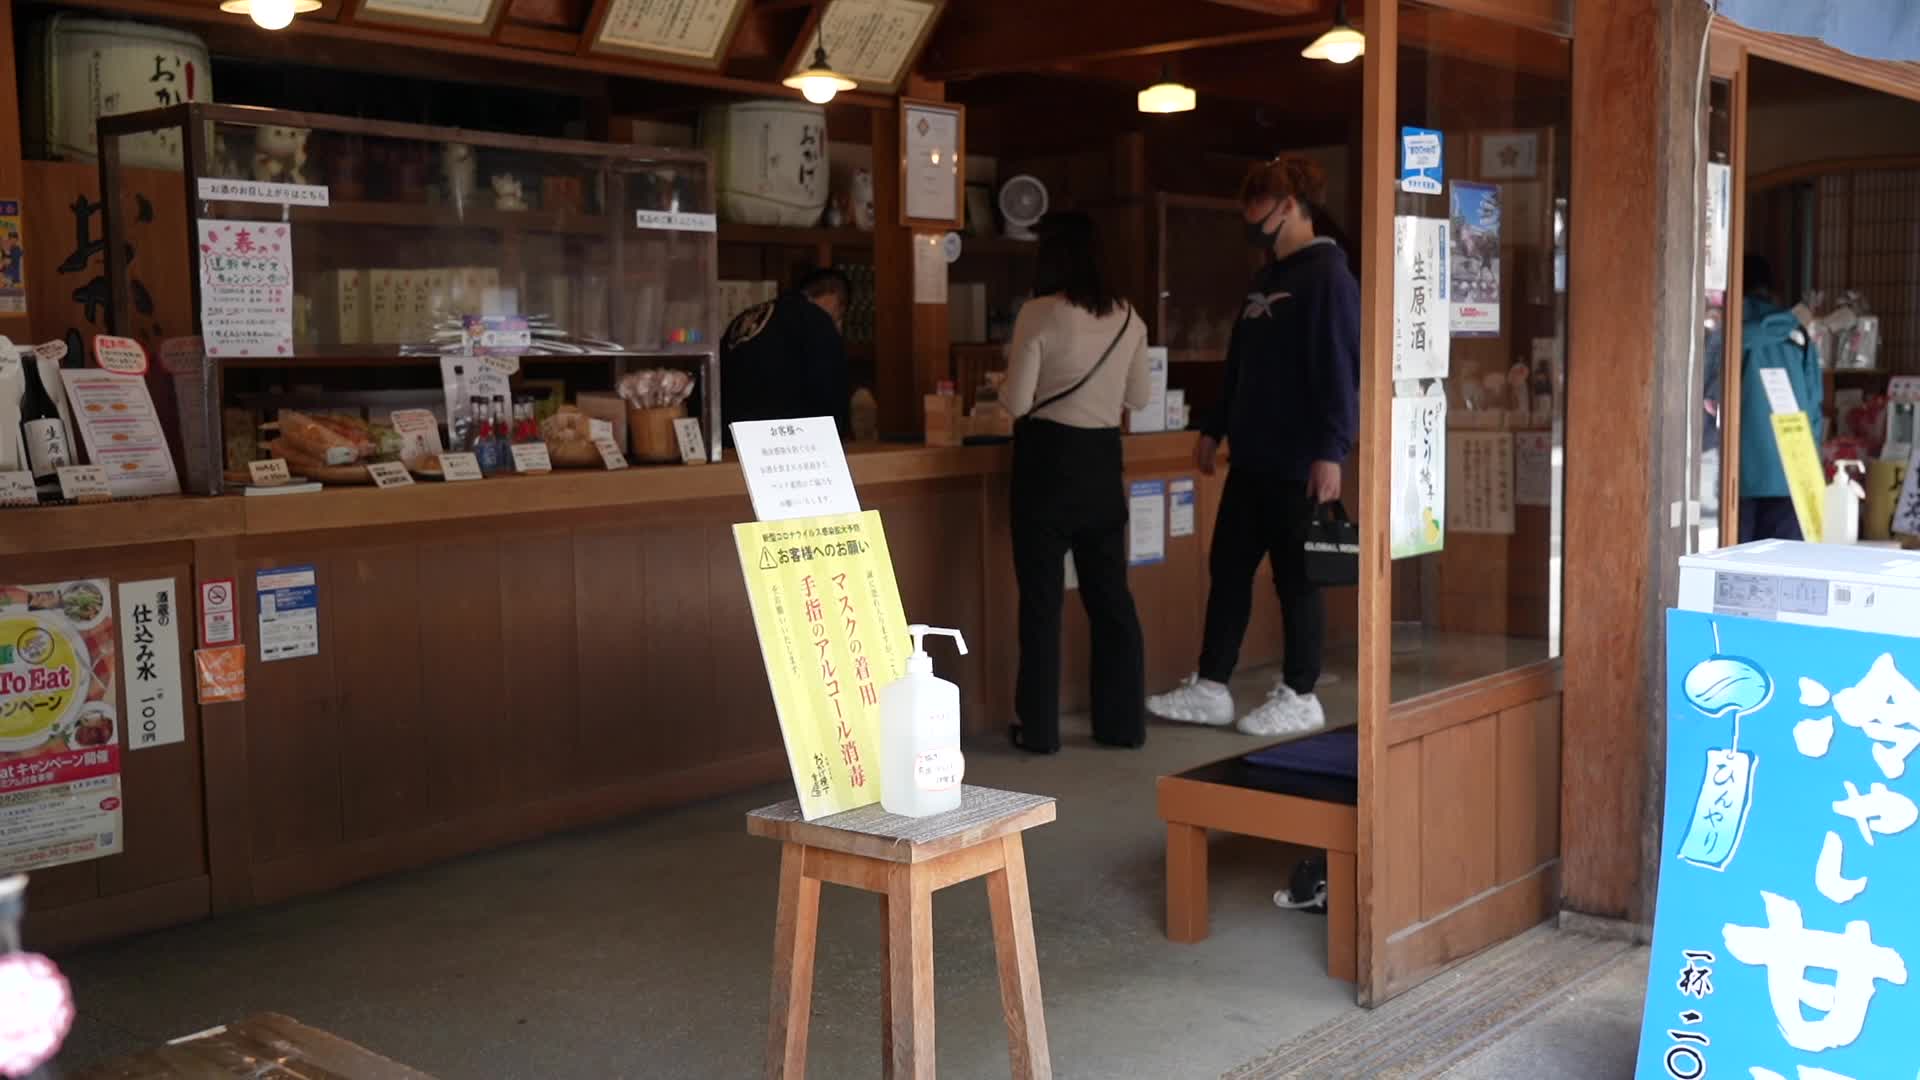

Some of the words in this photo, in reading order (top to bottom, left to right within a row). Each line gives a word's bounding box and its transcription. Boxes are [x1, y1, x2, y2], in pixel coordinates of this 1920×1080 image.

[1410, 252, 1427, 352] 生原酒
[769, 424, 805, 437] お客様へ
[778, 540, 870, 564] お客様へのお願い
[1304, 541, 1338, 552] GLOBAL
[155, 591, 170, 626] 酒蔵の
[133, 604, 158, 682] 仕込み水
[28, 666, 71, 692] Eat
[799, 574, 867, 789] 手指のアルコール消毒
[17, 750, 110, 775] キャンペーン開催
[1701, 762, 1737, 856] ひんやり
[1721, 652, 1920, 1080] 冷やし甘
[1678, 950, 1715, 998] 一杯
